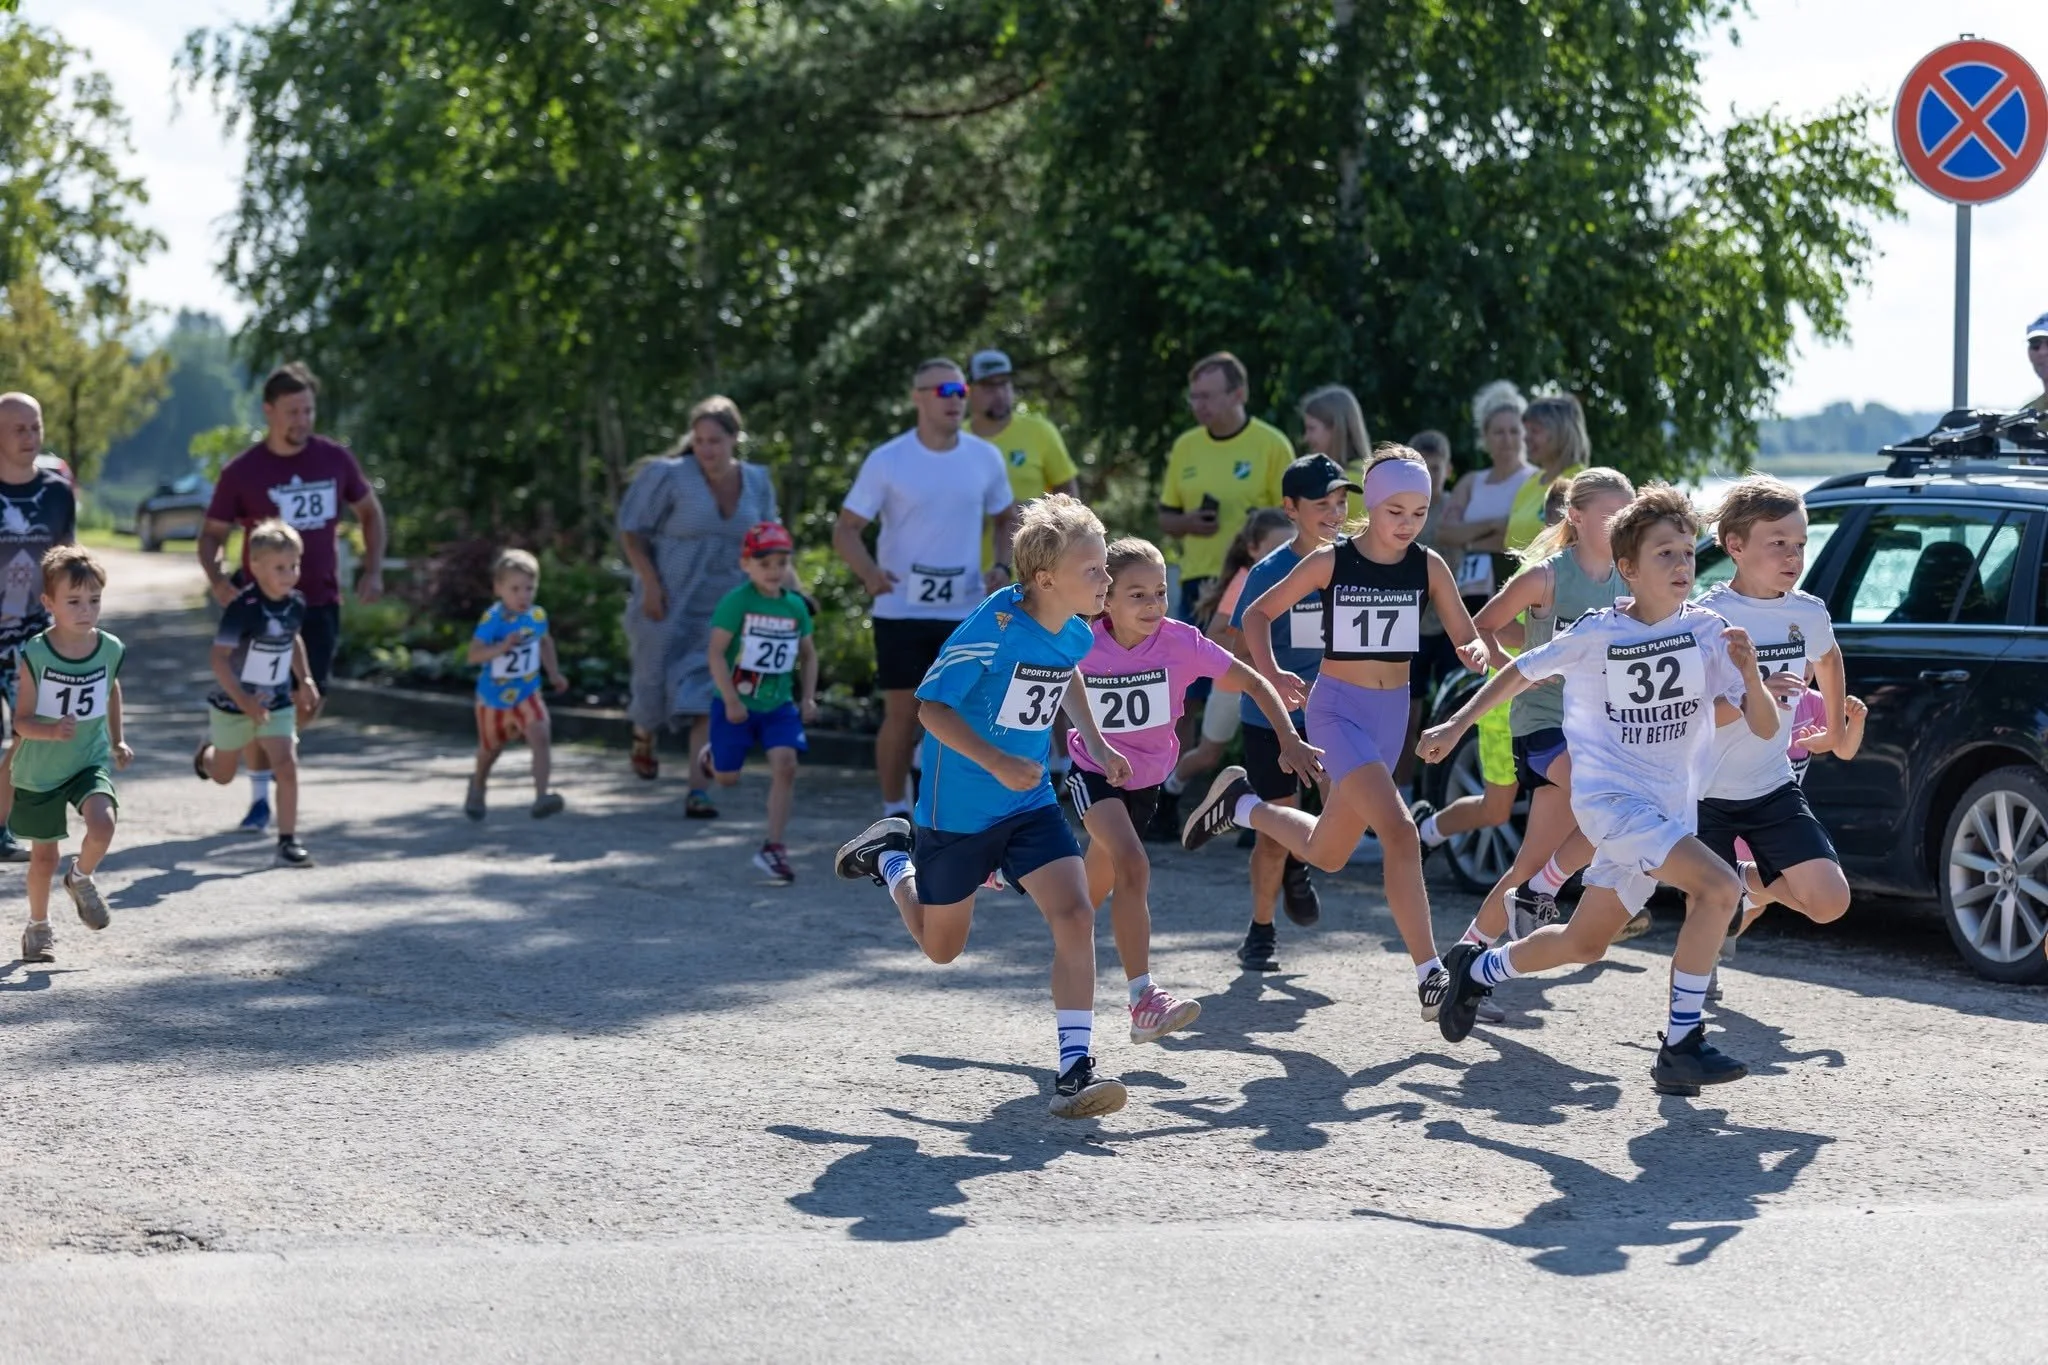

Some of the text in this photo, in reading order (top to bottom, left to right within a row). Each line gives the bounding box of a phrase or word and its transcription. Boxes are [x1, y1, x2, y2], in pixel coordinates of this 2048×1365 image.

[291, 493, 323, 518] 28
[920, 578, 953, 603] 24
[1339, 594, 1372, 602] SPORTS
[1352, 609, 1400, 647] 17
[504, 648, 532, 674] 27
[755, 641, 788, 669] 26
[1611, 645, 1648, 656] SPORTS
[1756, 649, 1770, 658] RTS
[47, 669, 76, 683] SPORTS
[268, 656, 281, 681] 1
[1020, 667, 1052, 678] SPORTS
[1087, 676, 1119, 685] SPORTS
[1626, 656, 1684, 705] 32
[55, 686, 95, 717] 15
[1018, 684, 1064, 726] 33
[1100, 689, 1150, 728] 20
[1604, 698, 1701, 724] Emirates
[1621, 720, 1688, 745] FLY BETTER
